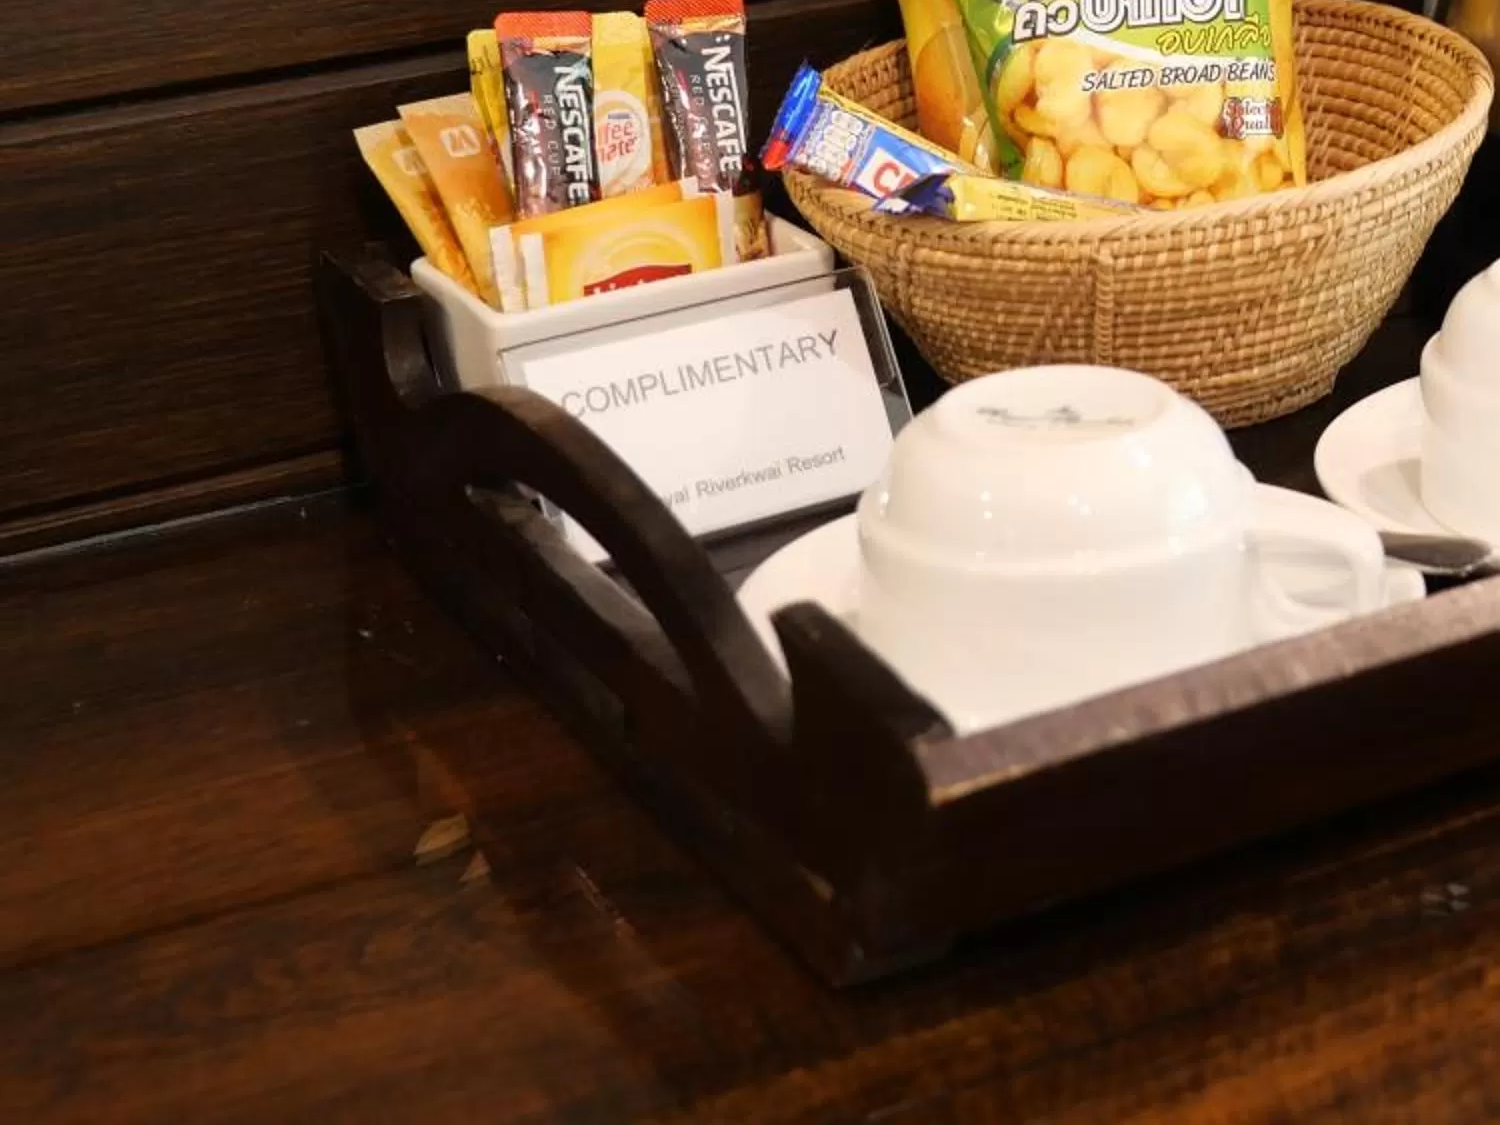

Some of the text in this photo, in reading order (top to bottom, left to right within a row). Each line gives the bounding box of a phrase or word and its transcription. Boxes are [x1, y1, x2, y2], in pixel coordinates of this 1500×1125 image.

[1082, 69, 1155, 92] SALTED
[1160, 65, 1221, 86] BROAD
[562, 330, 839, 418] COMPLIMENTARY
[695, 461, 783, 498] Riverkwai
[786, 446, 846, 475] Resort
